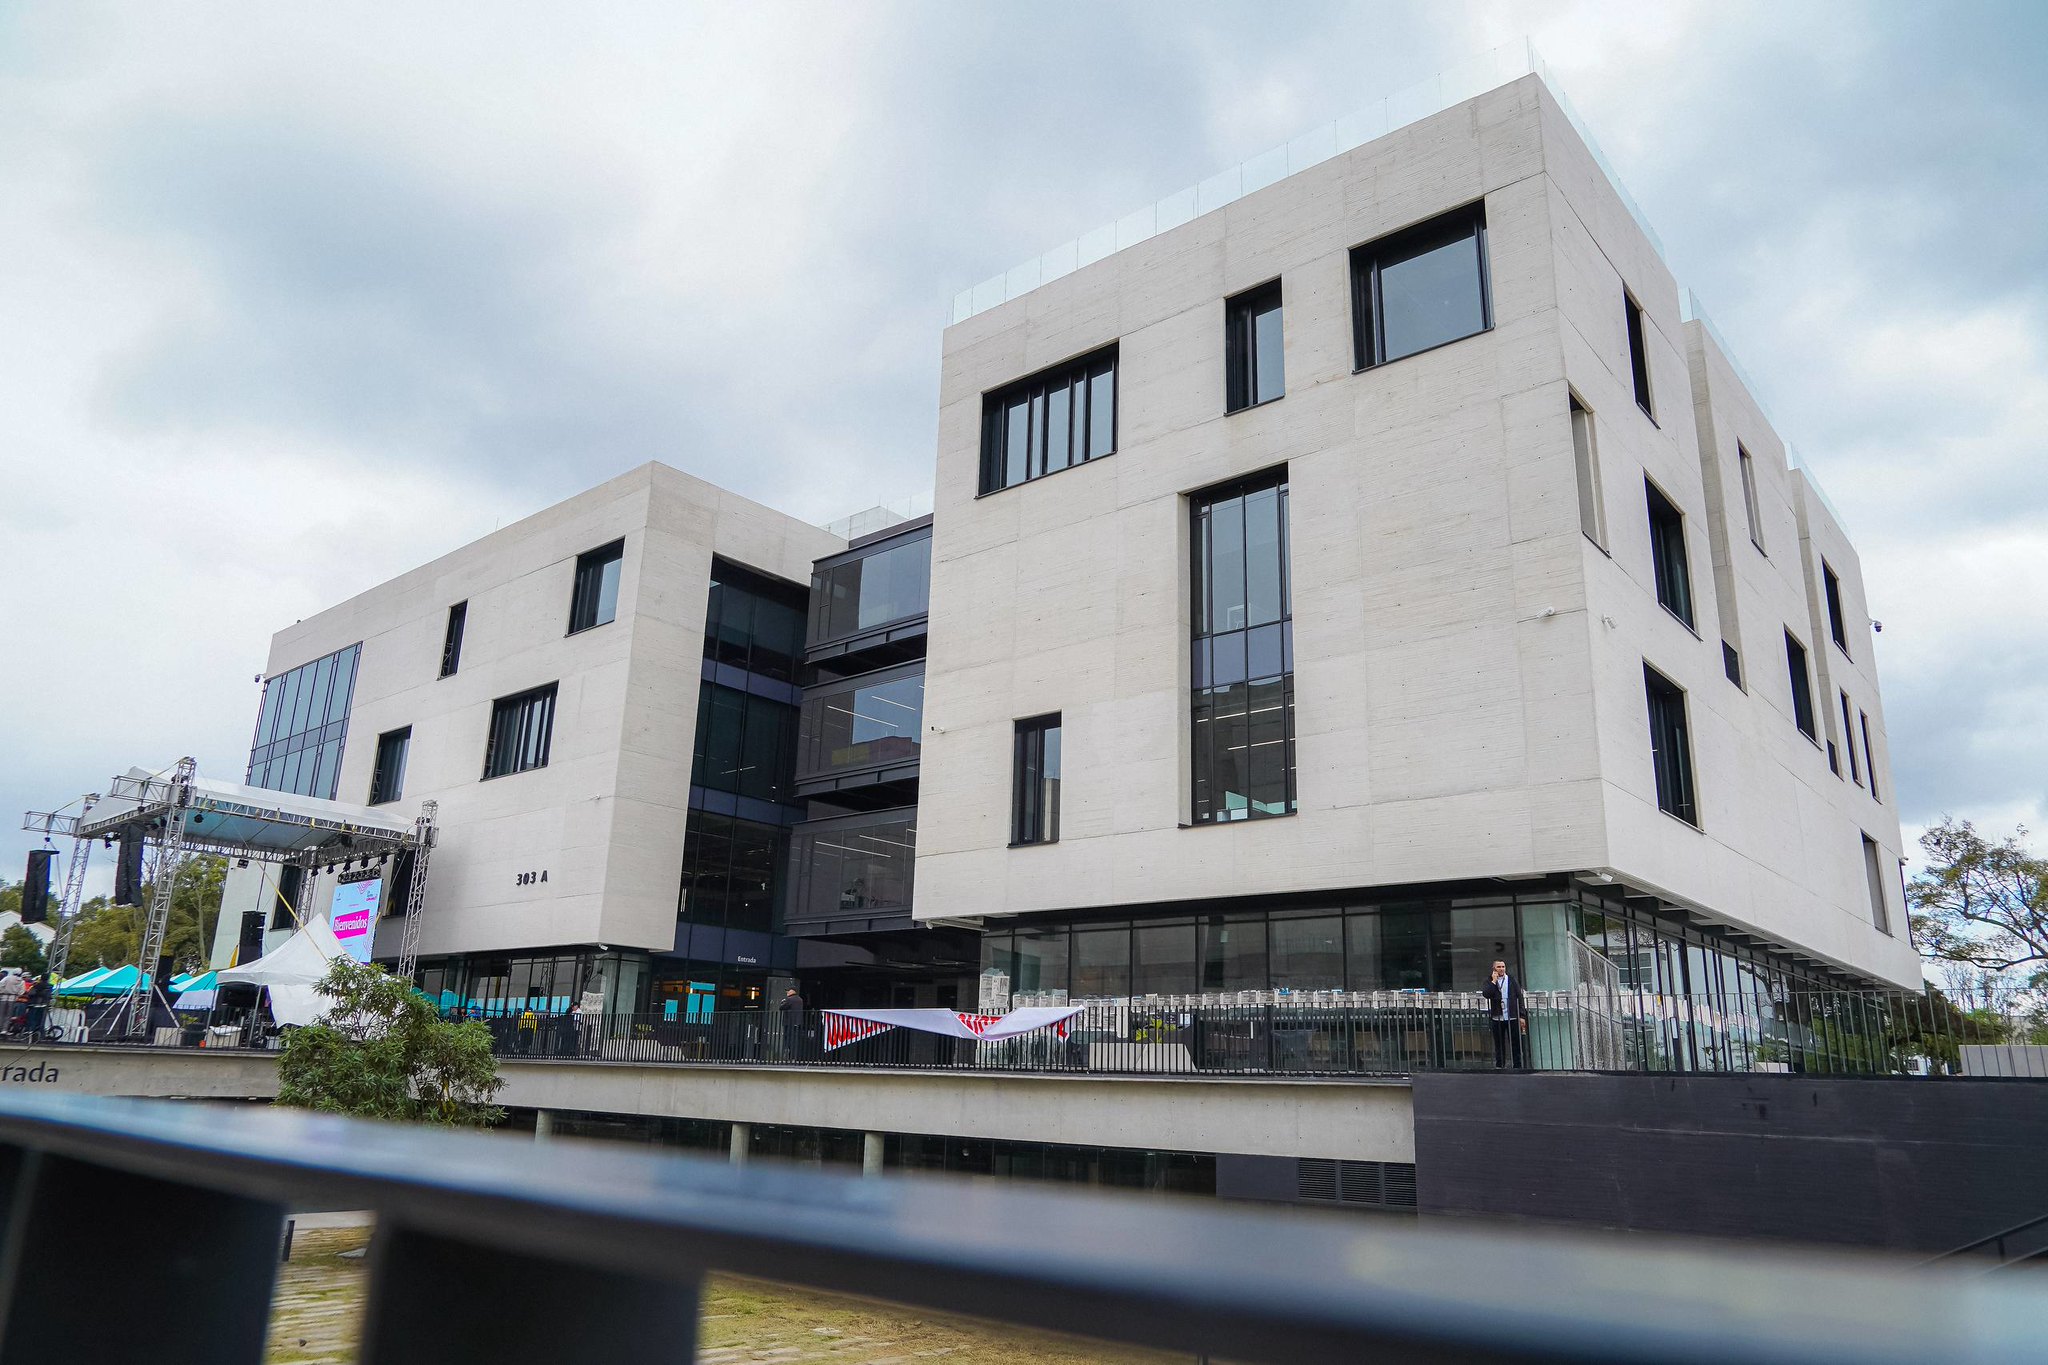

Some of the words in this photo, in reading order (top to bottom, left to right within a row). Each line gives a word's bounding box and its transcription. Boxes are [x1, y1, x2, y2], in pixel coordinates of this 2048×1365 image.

[515, 871, 537, 886] 303
[540, 870, 548, 883] A
[333, 915, 368, 932] Bienvenidos
[737, 955, 757, 964] Entrada
